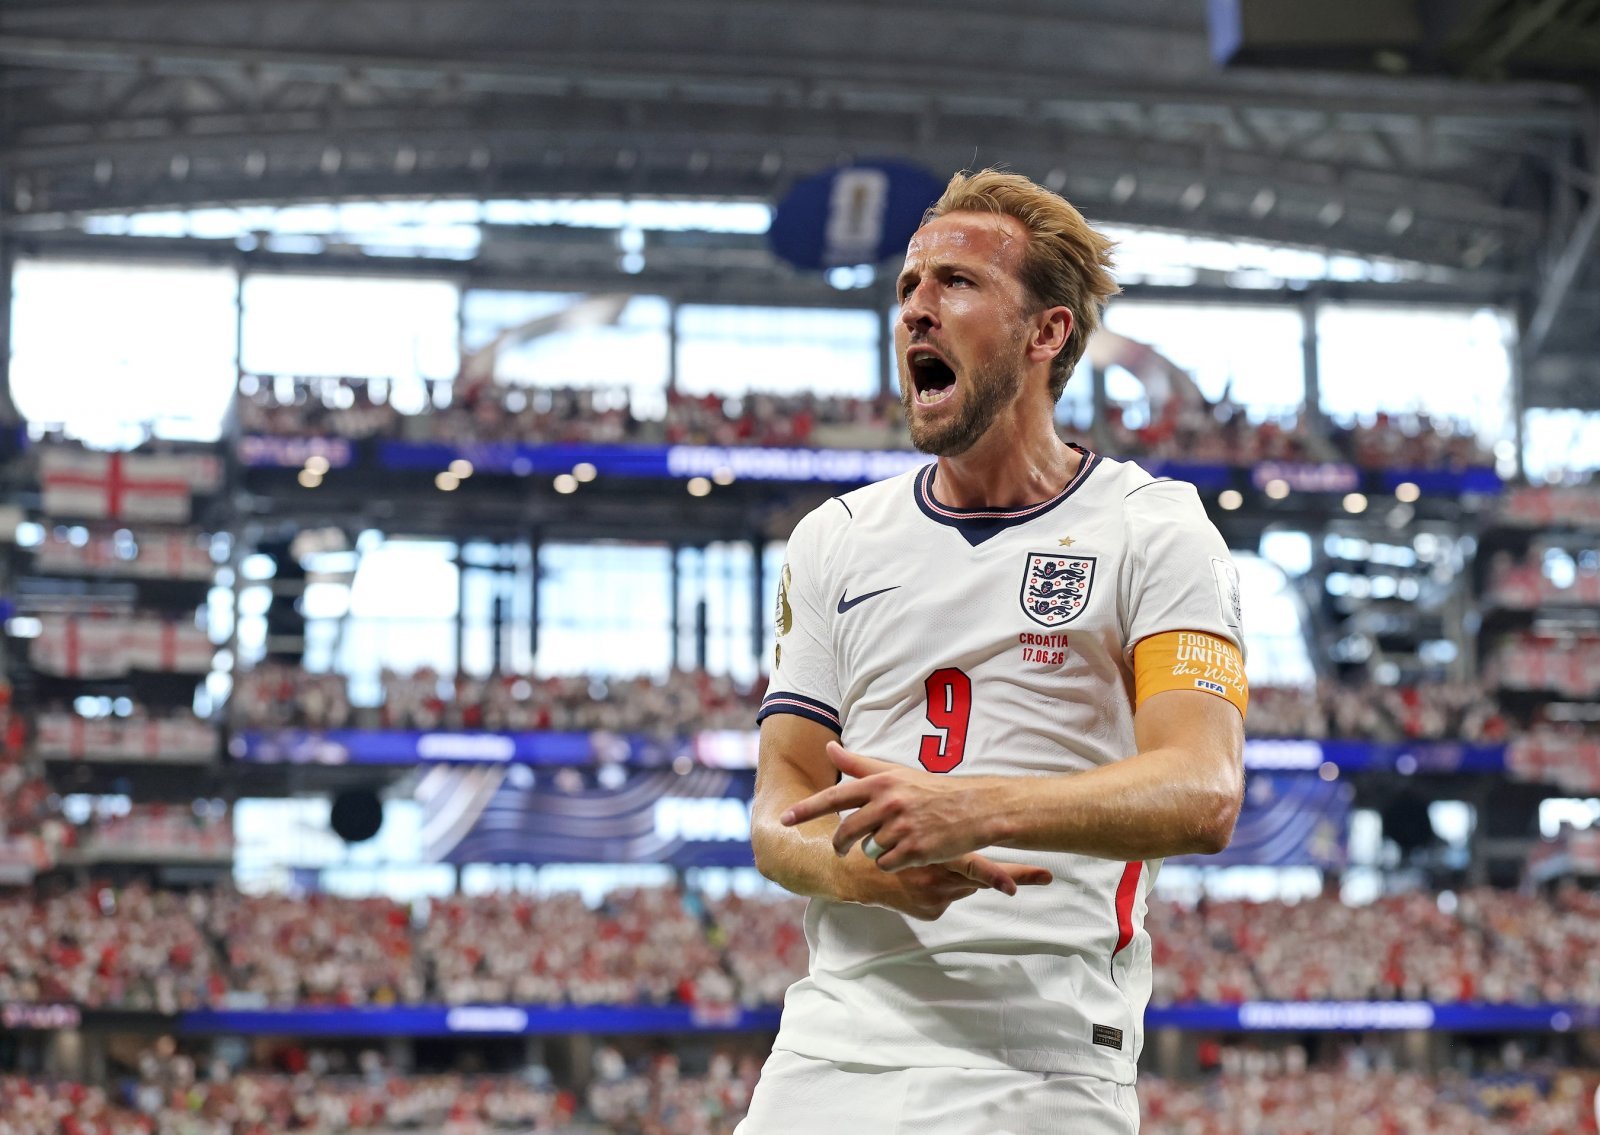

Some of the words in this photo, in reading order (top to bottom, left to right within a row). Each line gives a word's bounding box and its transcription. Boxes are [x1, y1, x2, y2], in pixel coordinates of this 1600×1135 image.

[1019, 633, 1068, 648] CROATIA
[1178, 633, 1239, 662] FOOTBALL
[1022, 648, 1064, 665] 17.06.26
[1176, 645, 1242, 679] UNITES
[1171, 661, 1201, 676] the
[1204, 663, 1245, 696] World
[1197, 680, 1224, 694] FIFA
[918, 667, 972, 773] 9
